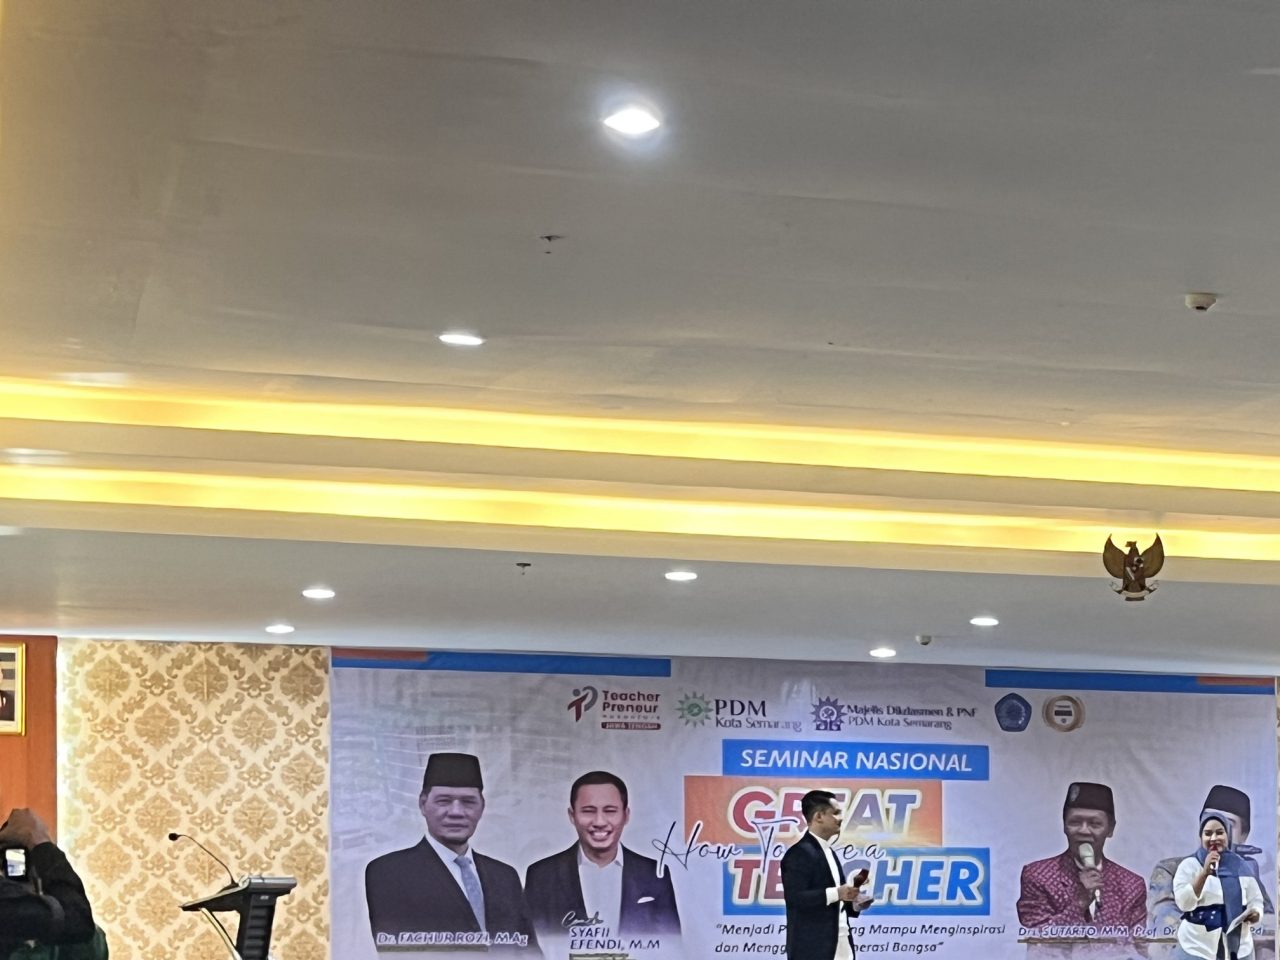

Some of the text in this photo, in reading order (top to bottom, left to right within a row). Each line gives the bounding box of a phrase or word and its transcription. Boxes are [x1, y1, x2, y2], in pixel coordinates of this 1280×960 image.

[602, 690, 661, 703] Teacher
[602, 701, 659, 713] Preneur
[715, 699, 767, 717] PDM
[716, 717, 803, 732] Kota Semarang
[848, 715, 953, 731] PDM Kota Semarang
[740, 748, 973, 772] SEMINAR NASIONAL
[730, 786, 918, 835] GRAT
[651, 820, 743, 877] How
[731, 857, 981, 902] TECHER
[571, 927, 610, 938] SYAFII
[869, 924, 917, 937] Mampu
[920, 924, 1006, 937] Menginspirasi
[1042, 925, 1097, 937] SUTARTO
[715, 942, 739, 953] dan
